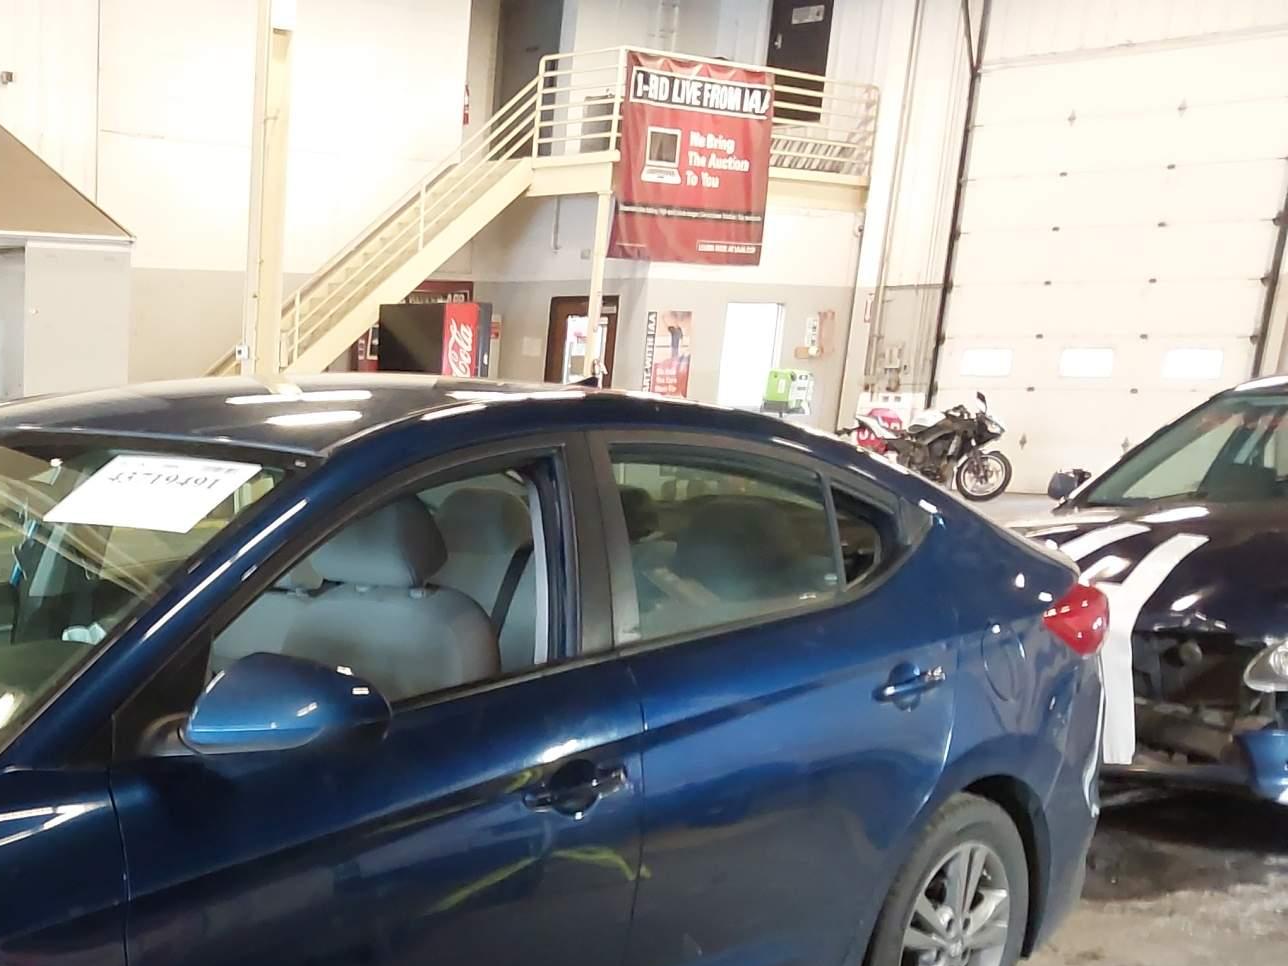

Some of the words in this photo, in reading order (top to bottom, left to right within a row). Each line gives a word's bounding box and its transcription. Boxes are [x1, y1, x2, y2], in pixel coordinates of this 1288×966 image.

[671, 77, 703, 106] LIVE
[703, 80, 741, 111] FROM
[706, 132, 736, 154] Bring
[688, 150, 707, 168] The
[707, 152, 750, 172] Auction
[685, 169, 699, 187] To
[700, 170, 720, 188] You
